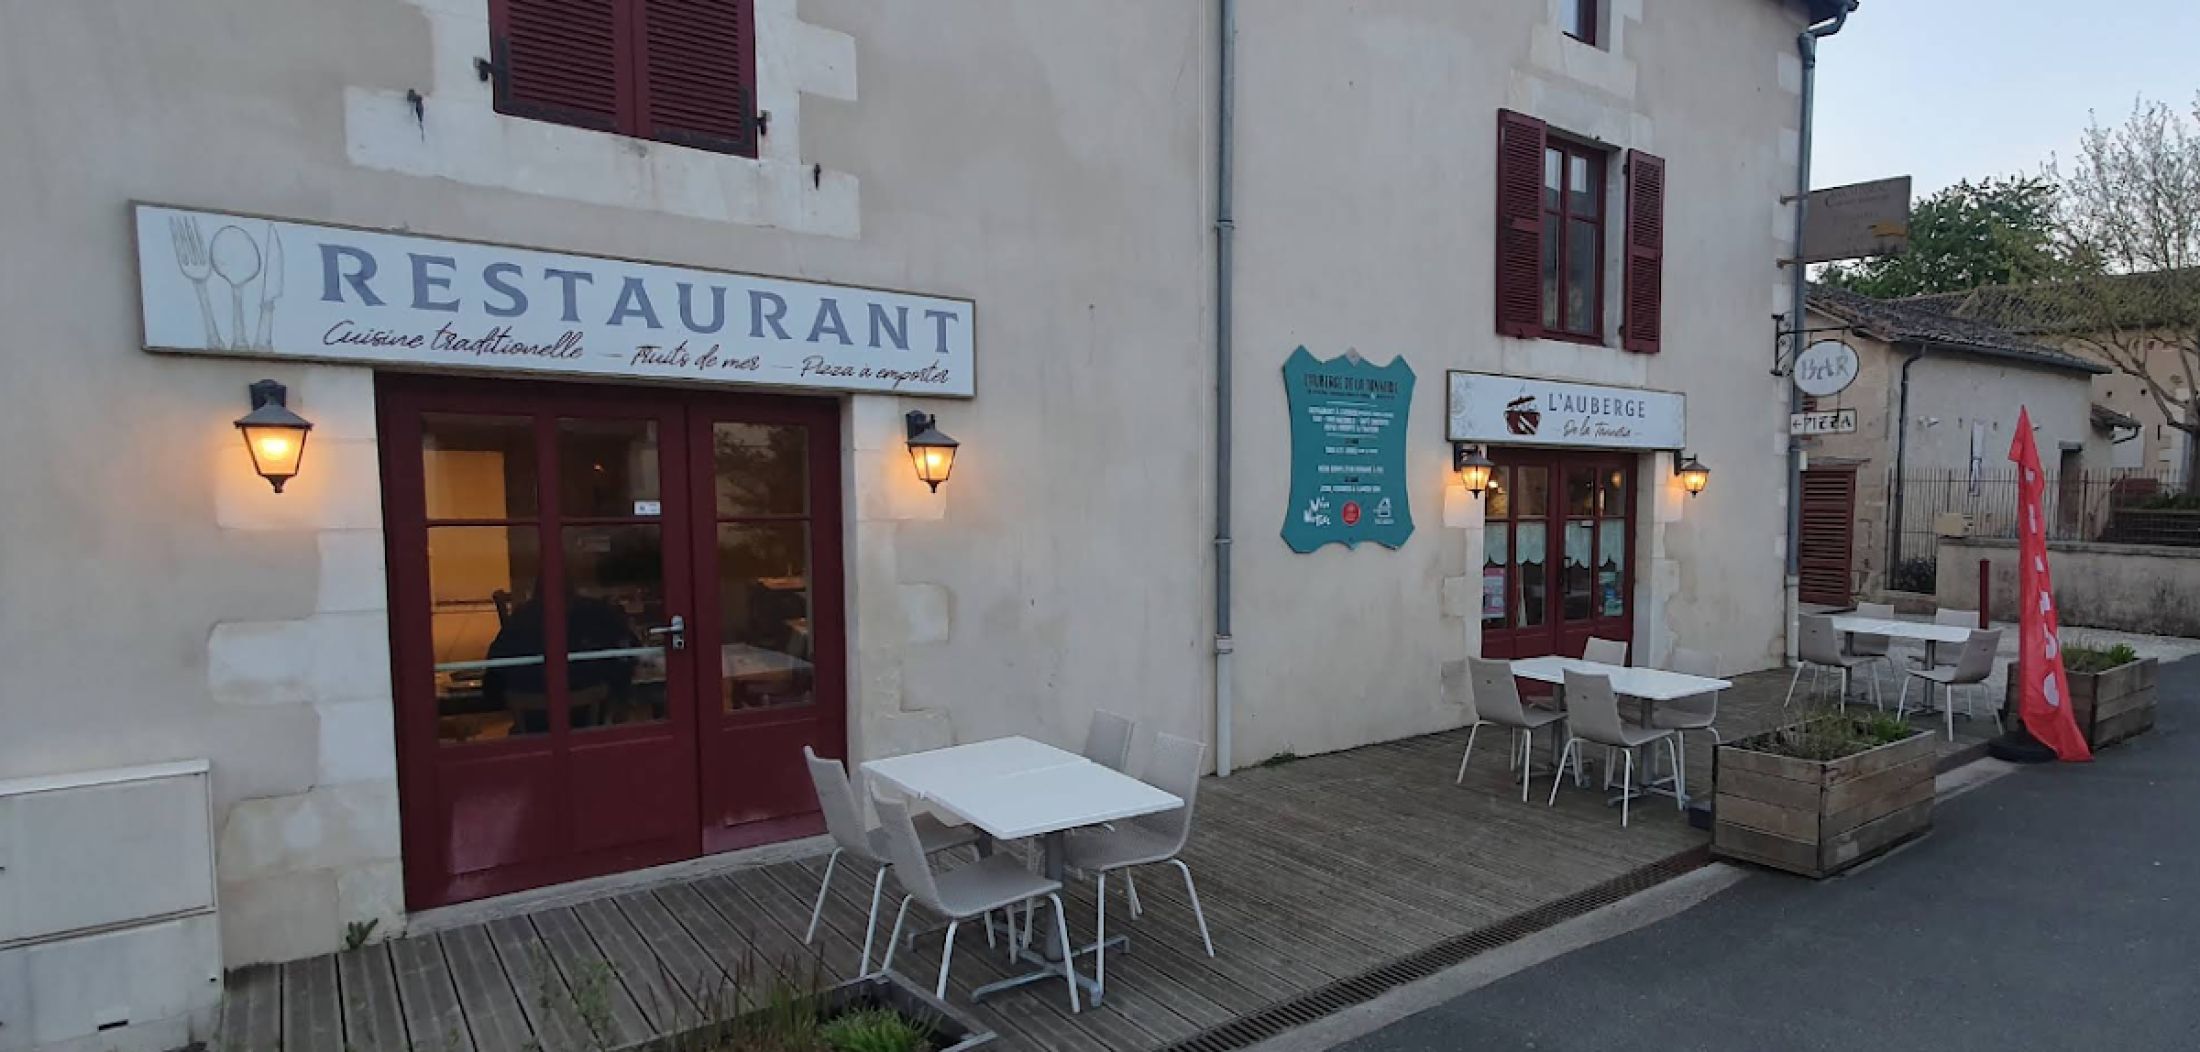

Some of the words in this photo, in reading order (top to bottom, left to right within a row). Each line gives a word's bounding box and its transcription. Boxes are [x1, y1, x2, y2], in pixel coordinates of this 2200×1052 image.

[318, 243, 959, 353] RESTAURANT
[323, 319, 424, 349] Cuisine
[630, 338, 690, 368] Fruits
[694, 343, 719, 371] de
[722, 355, 760, 372] mer
[1801, 355, 1849, 380] BAR
[800, 355, 854, 378] Pizza
[875, 359, 951, 390] emporter
[1548, 392, 1646, 418] L'AUBERGE
[1804, 414, 1852, 431] PIZZA
